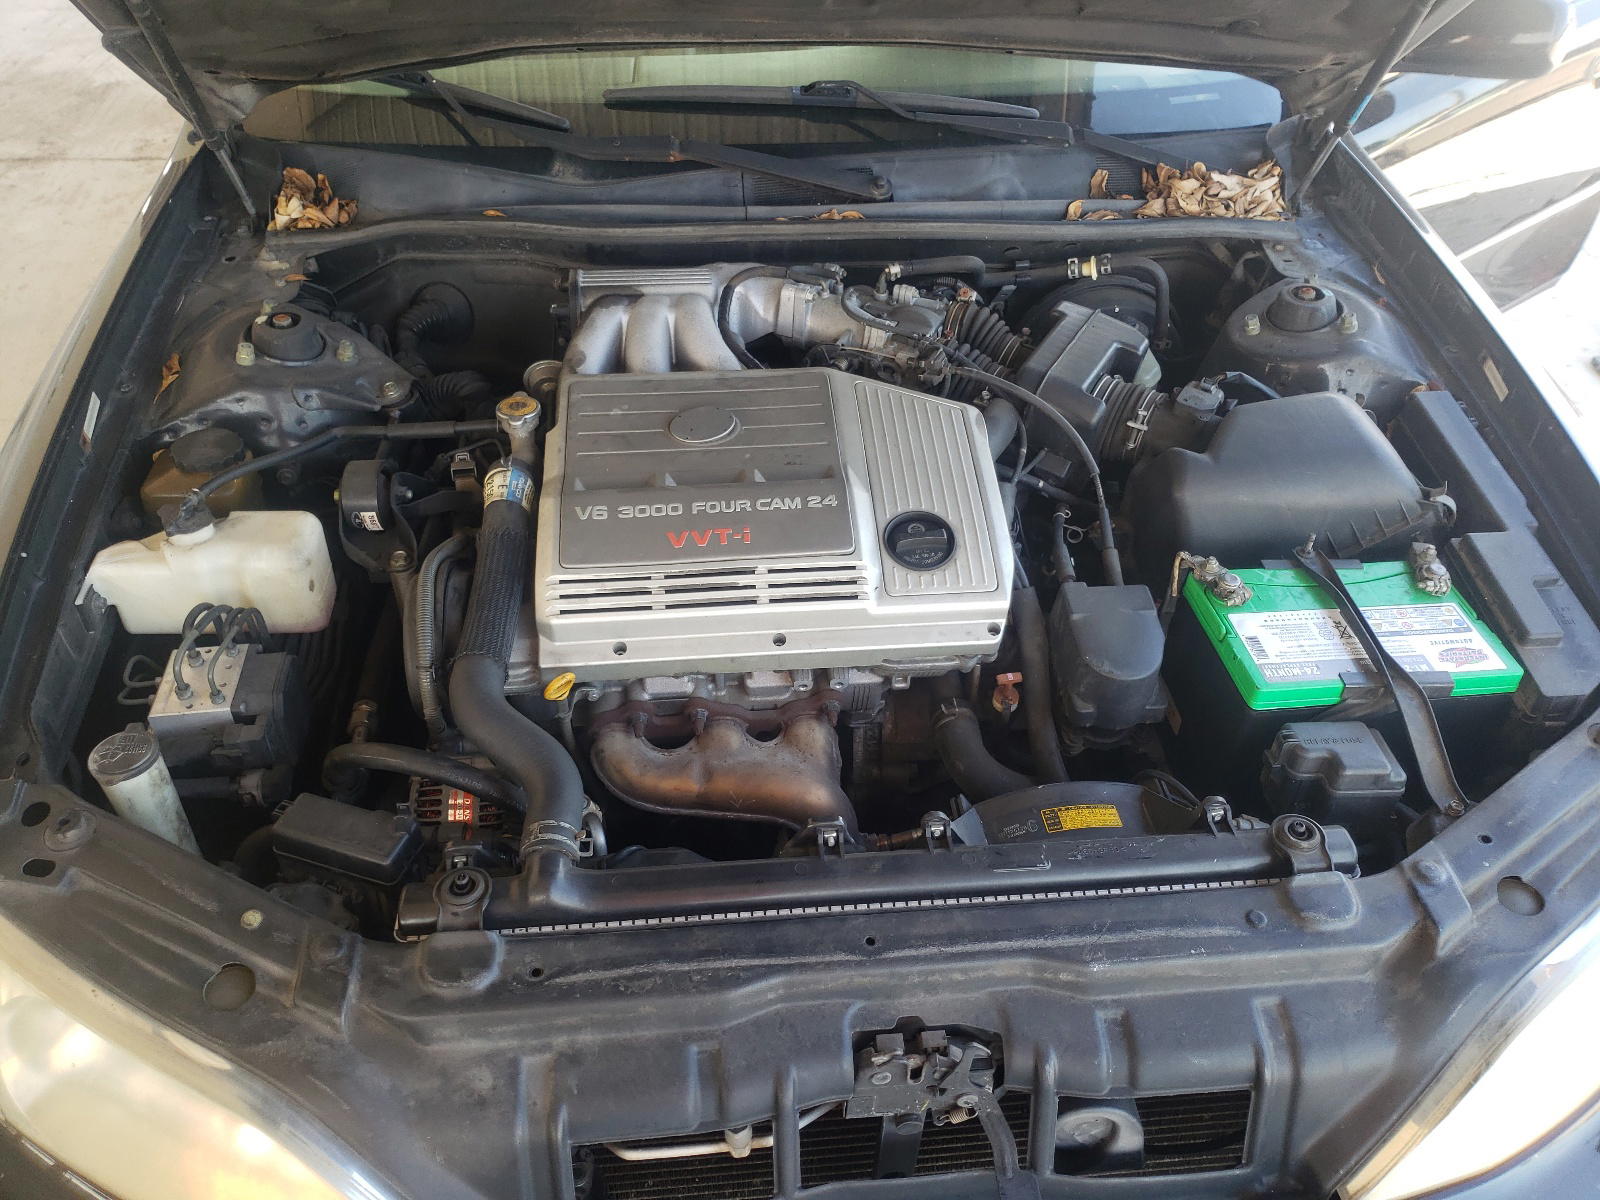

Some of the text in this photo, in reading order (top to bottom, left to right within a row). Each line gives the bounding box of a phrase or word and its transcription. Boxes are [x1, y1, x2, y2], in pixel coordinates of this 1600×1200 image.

[574, 493, 839, 521] V6 3000 FOUR CAM 24
[666, 526, 752, 549] VVT-i
[1429, 638, 1473, 646] AUTOMOTIVE
[1263, 666, 1321, 678] 24-MONTH
